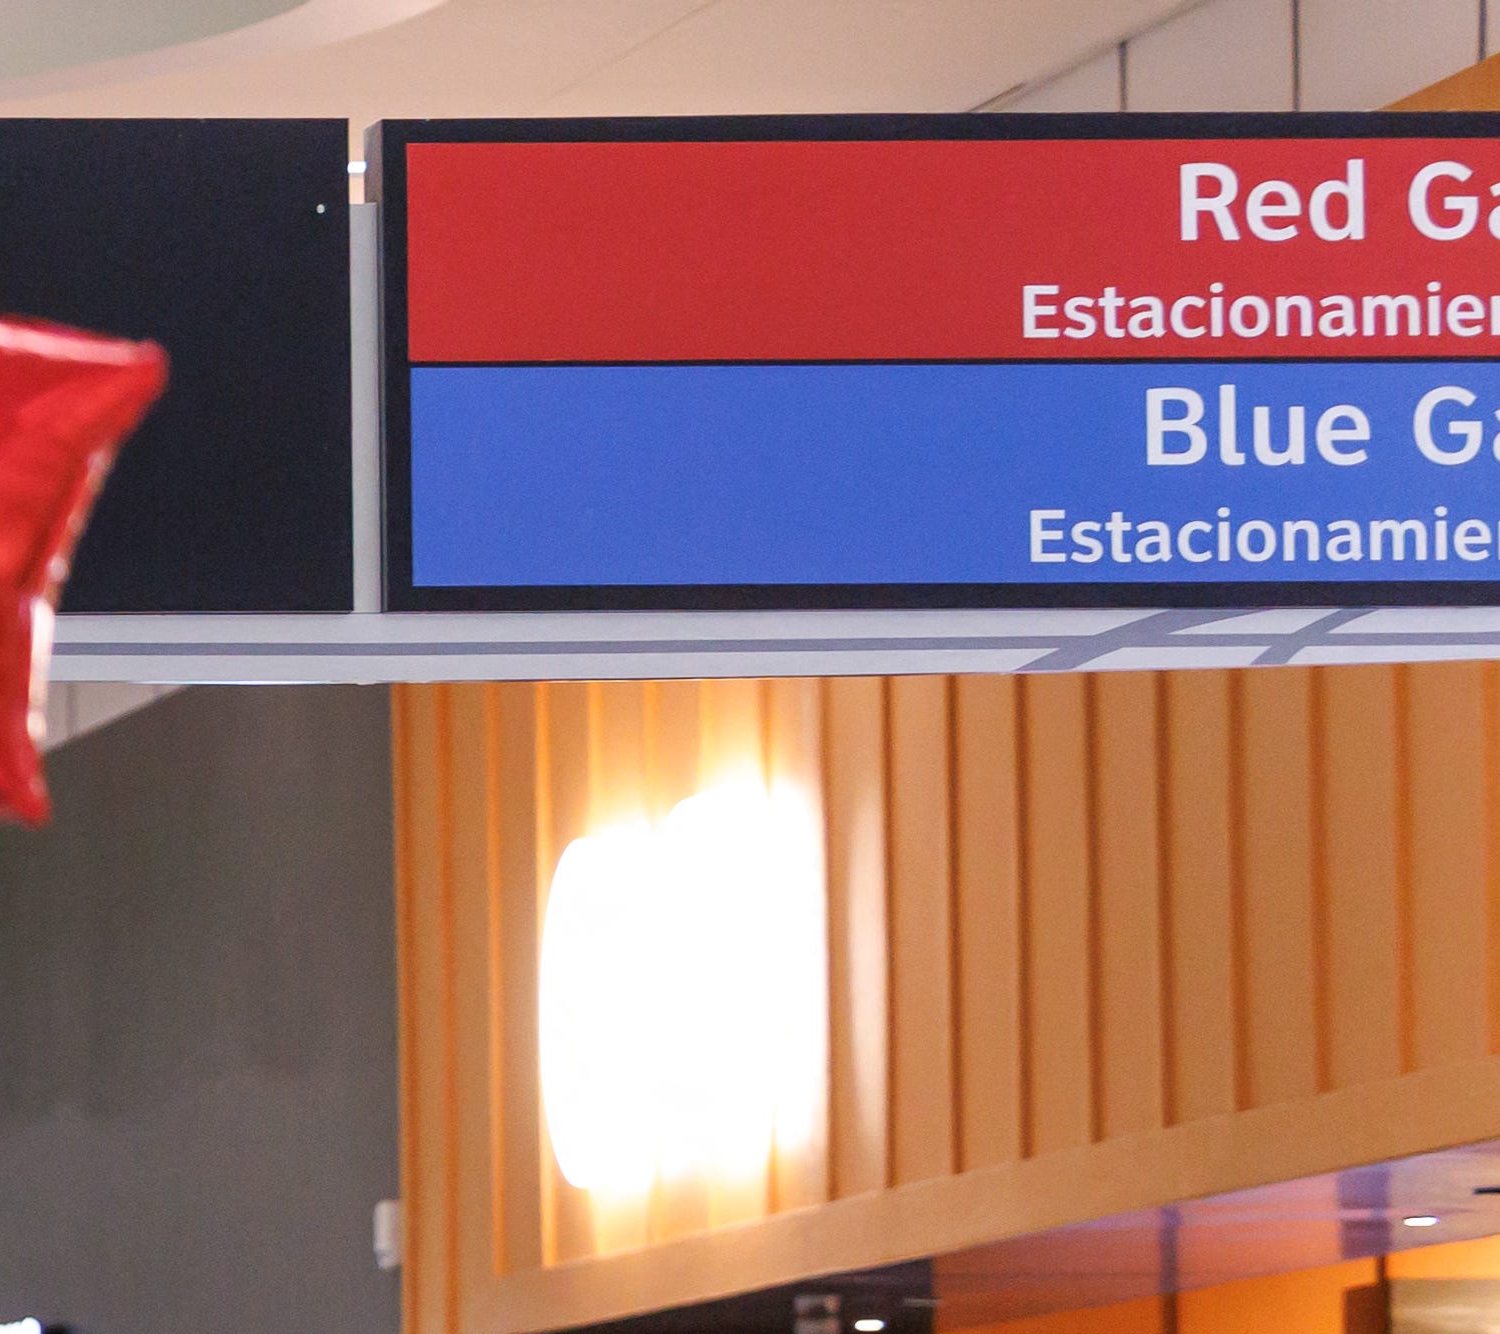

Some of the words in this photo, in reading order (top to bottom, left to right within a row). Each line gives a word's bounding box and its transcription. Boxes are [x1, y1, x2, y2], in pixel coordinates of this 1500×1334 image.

[1179, 158, 1366, 242] Red
[1407, 159, 1500, 242] G
[1022, 280, 1500, 340] Estacionamie
[1145, 384, 1372, 467] Blue
[1029, 505, 1500, 564] Estacionamie
